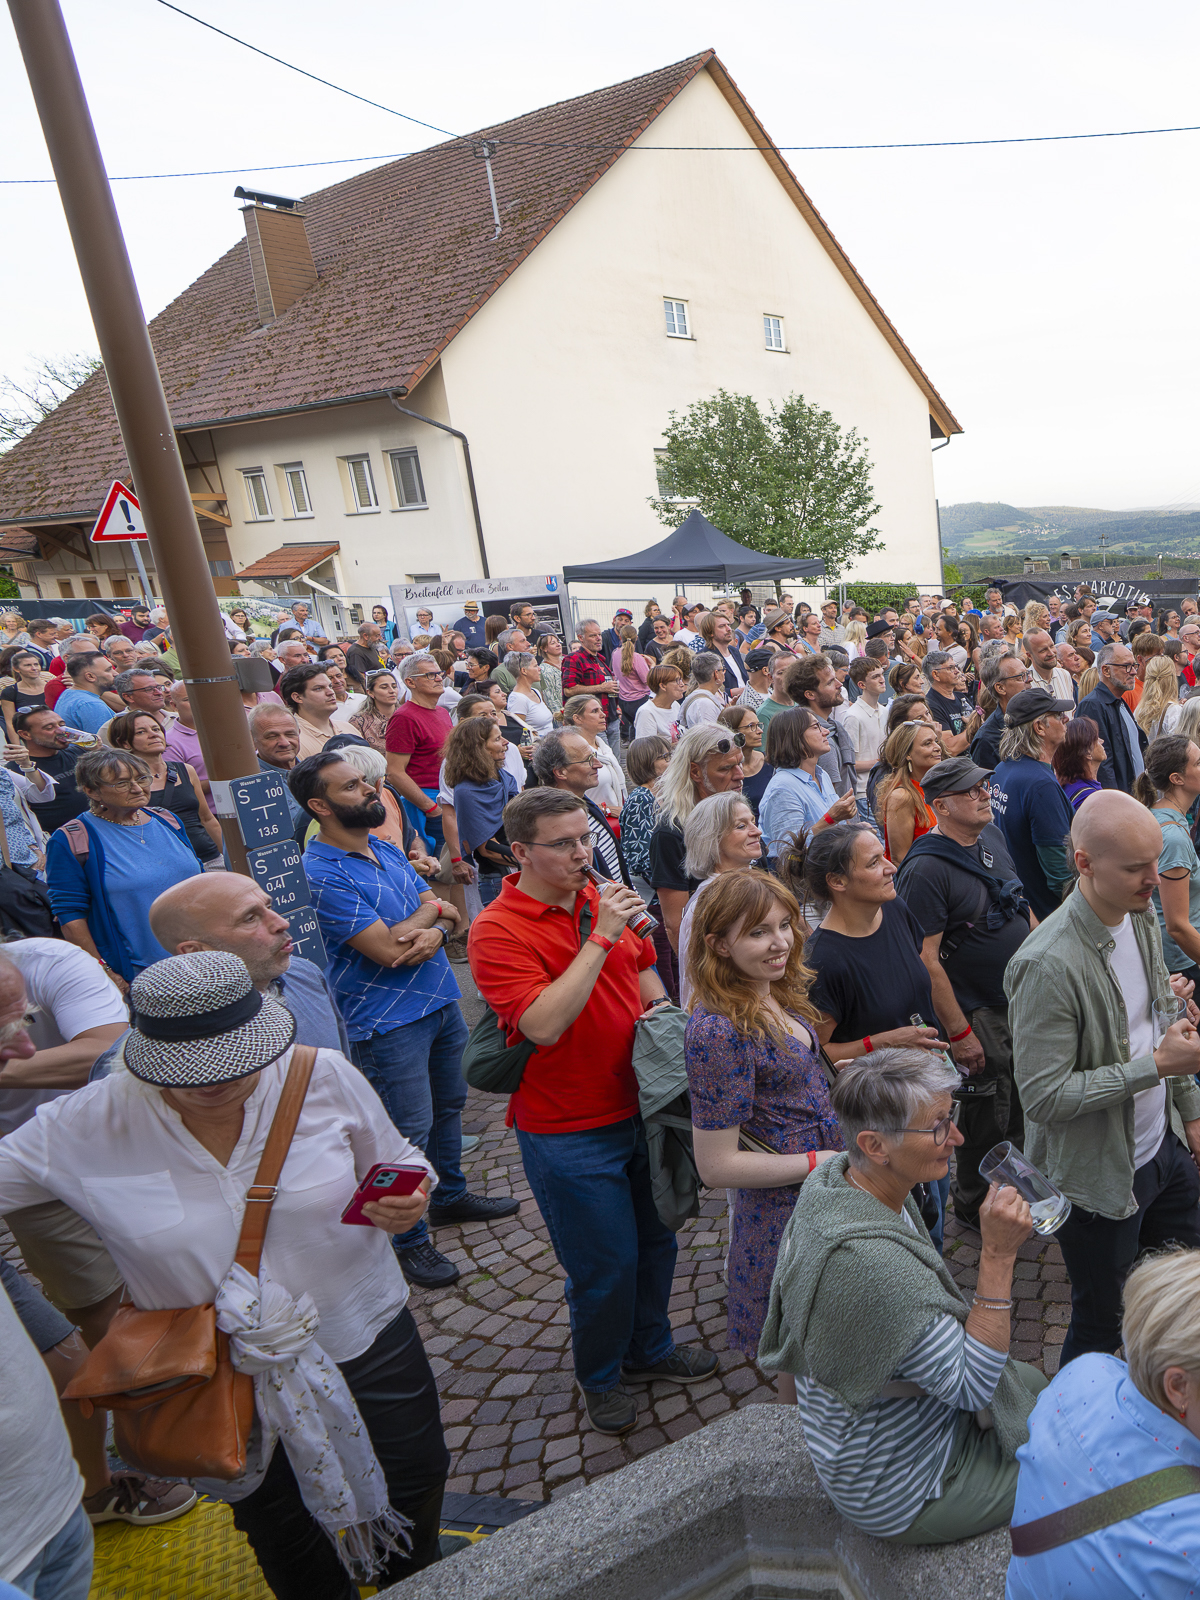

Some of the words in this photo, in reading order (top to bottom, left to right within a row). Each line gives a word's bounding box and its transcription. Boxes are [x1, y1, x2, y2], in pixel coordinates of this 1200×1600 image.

[402, 585, 453, 600] Breitenfeld
[466, 584, 484, 594] alten
[1080, 580, 1149, 602] ARCOTIK
[237, 789, 250, 804] S
[265, 786, 283, 798] 100
[255, 860, 268, 874] S
[282, 855, 300, 867] 100
[299, 921, 316, 934] 100
